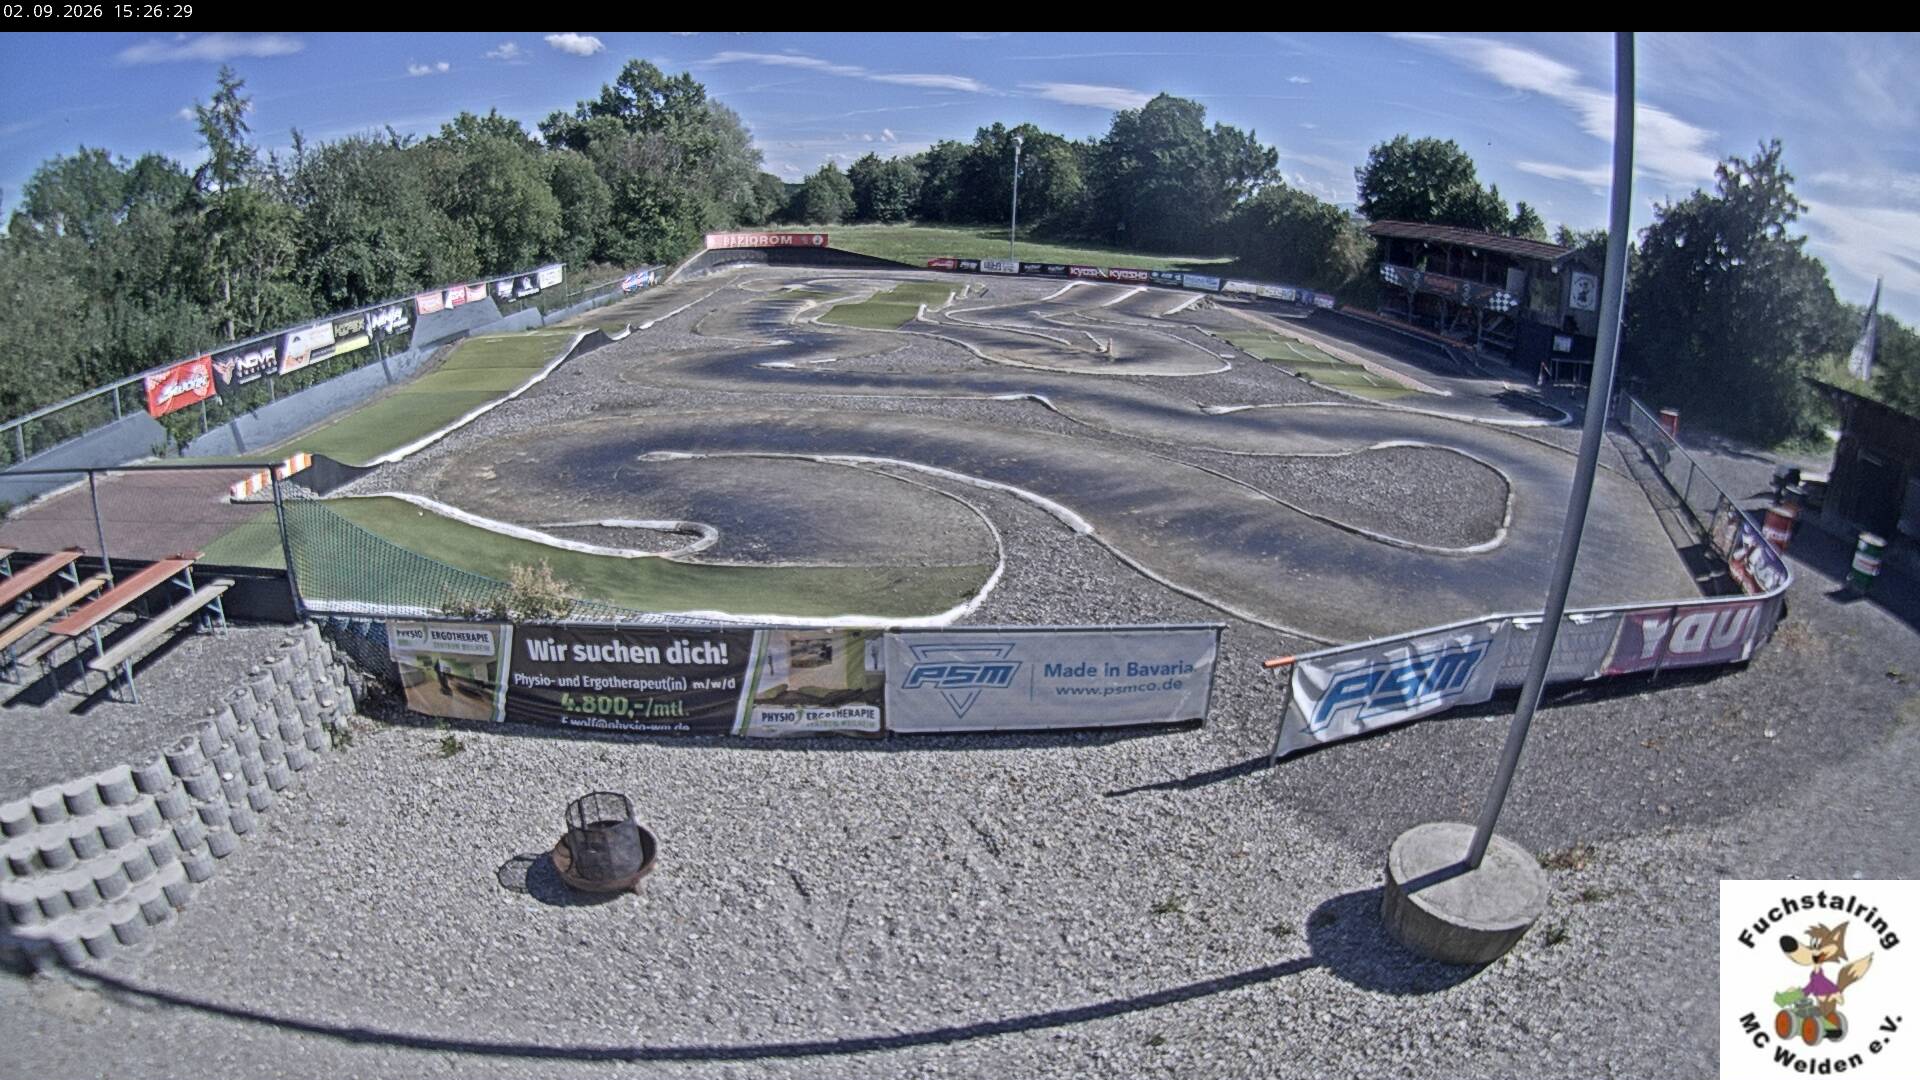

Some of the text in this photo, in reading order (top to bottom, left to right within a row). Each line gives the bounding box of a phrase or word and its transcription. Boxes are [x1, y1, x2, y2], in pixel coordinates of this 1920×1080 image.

[431, 630, 489, 643] ERGOTHERAPIE
[526, 638, 729, 665] Wir suchen dich!
[903, 663, 1017, 688] PSM
[1043, 660, 1195, 678] Made in Bavaria
[514, 673, 736, 692] Physio- und Ergotherapeut(in) m/w/d
[1055, 678, 1183, 697] www.psmco.de
[761, 711, 796, 723] PHYSIO
